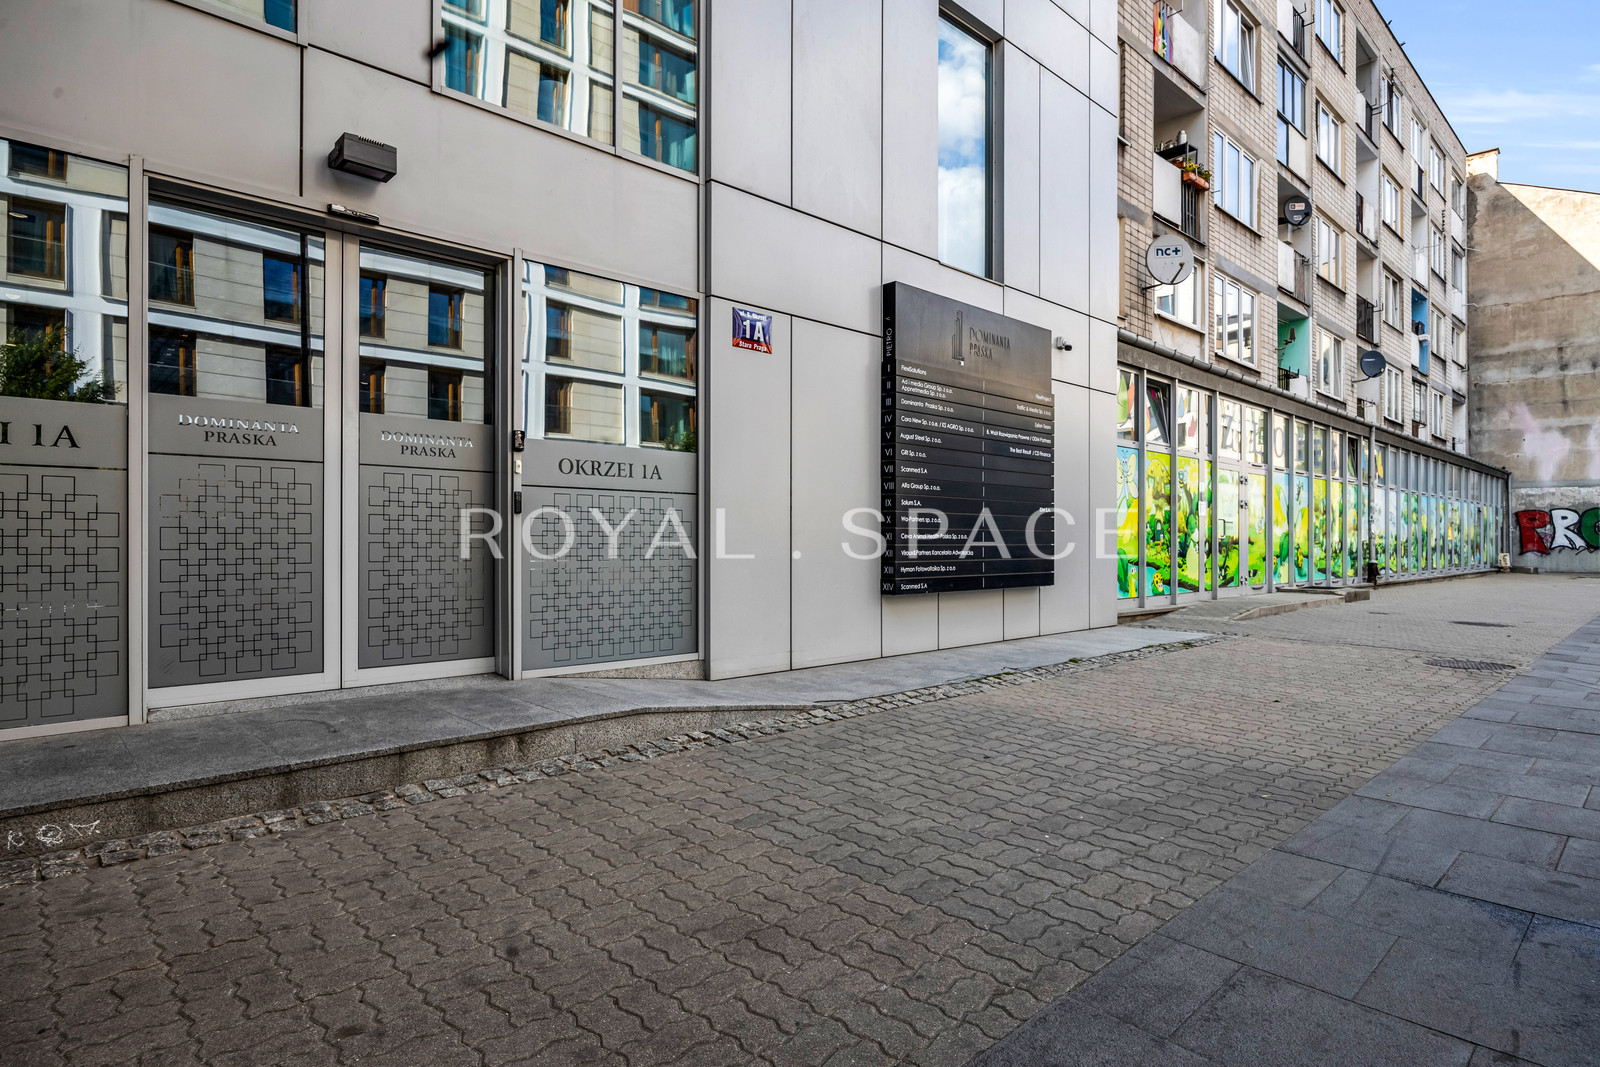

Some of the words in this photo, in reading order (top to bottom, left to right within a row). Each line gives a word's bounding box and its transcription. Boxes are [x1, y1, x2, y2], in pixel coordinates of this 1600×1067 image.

[1156, 247, 1181, 257] nc+
[970, 327, 1010, 351] DOMINANTA
[739, 341, 752, 349] Stara
[754, 344, 769, 352] Praga
[970, 342, 993, 360] PRASKA
[887, 381, 891, 389] II
[901, 399, 924, 407] Dominanta
[885, 415, 892, 423] IV
[178, 414, 300, 435] DOMINANTA
[204, 430, 277, 446] PRASKA
[381, 430, 474, 448] DOMINANTA
[886, 432, 891, 440] V
[900, 433, 914, 441] August
[400, 445, 456, 459] PRASKA
[558, 457, 634, 479] OKRZEI
[642, 464, 663, 481] 1A
[884, 465, 894, 473] VII
[884, 482, 895, 490] VIII
[887, 516, 892, 524] X
[885, 550, 894, 558] XII
[884, 566, 895, 574] XIII
[883, 582, 894, 590] XIV
